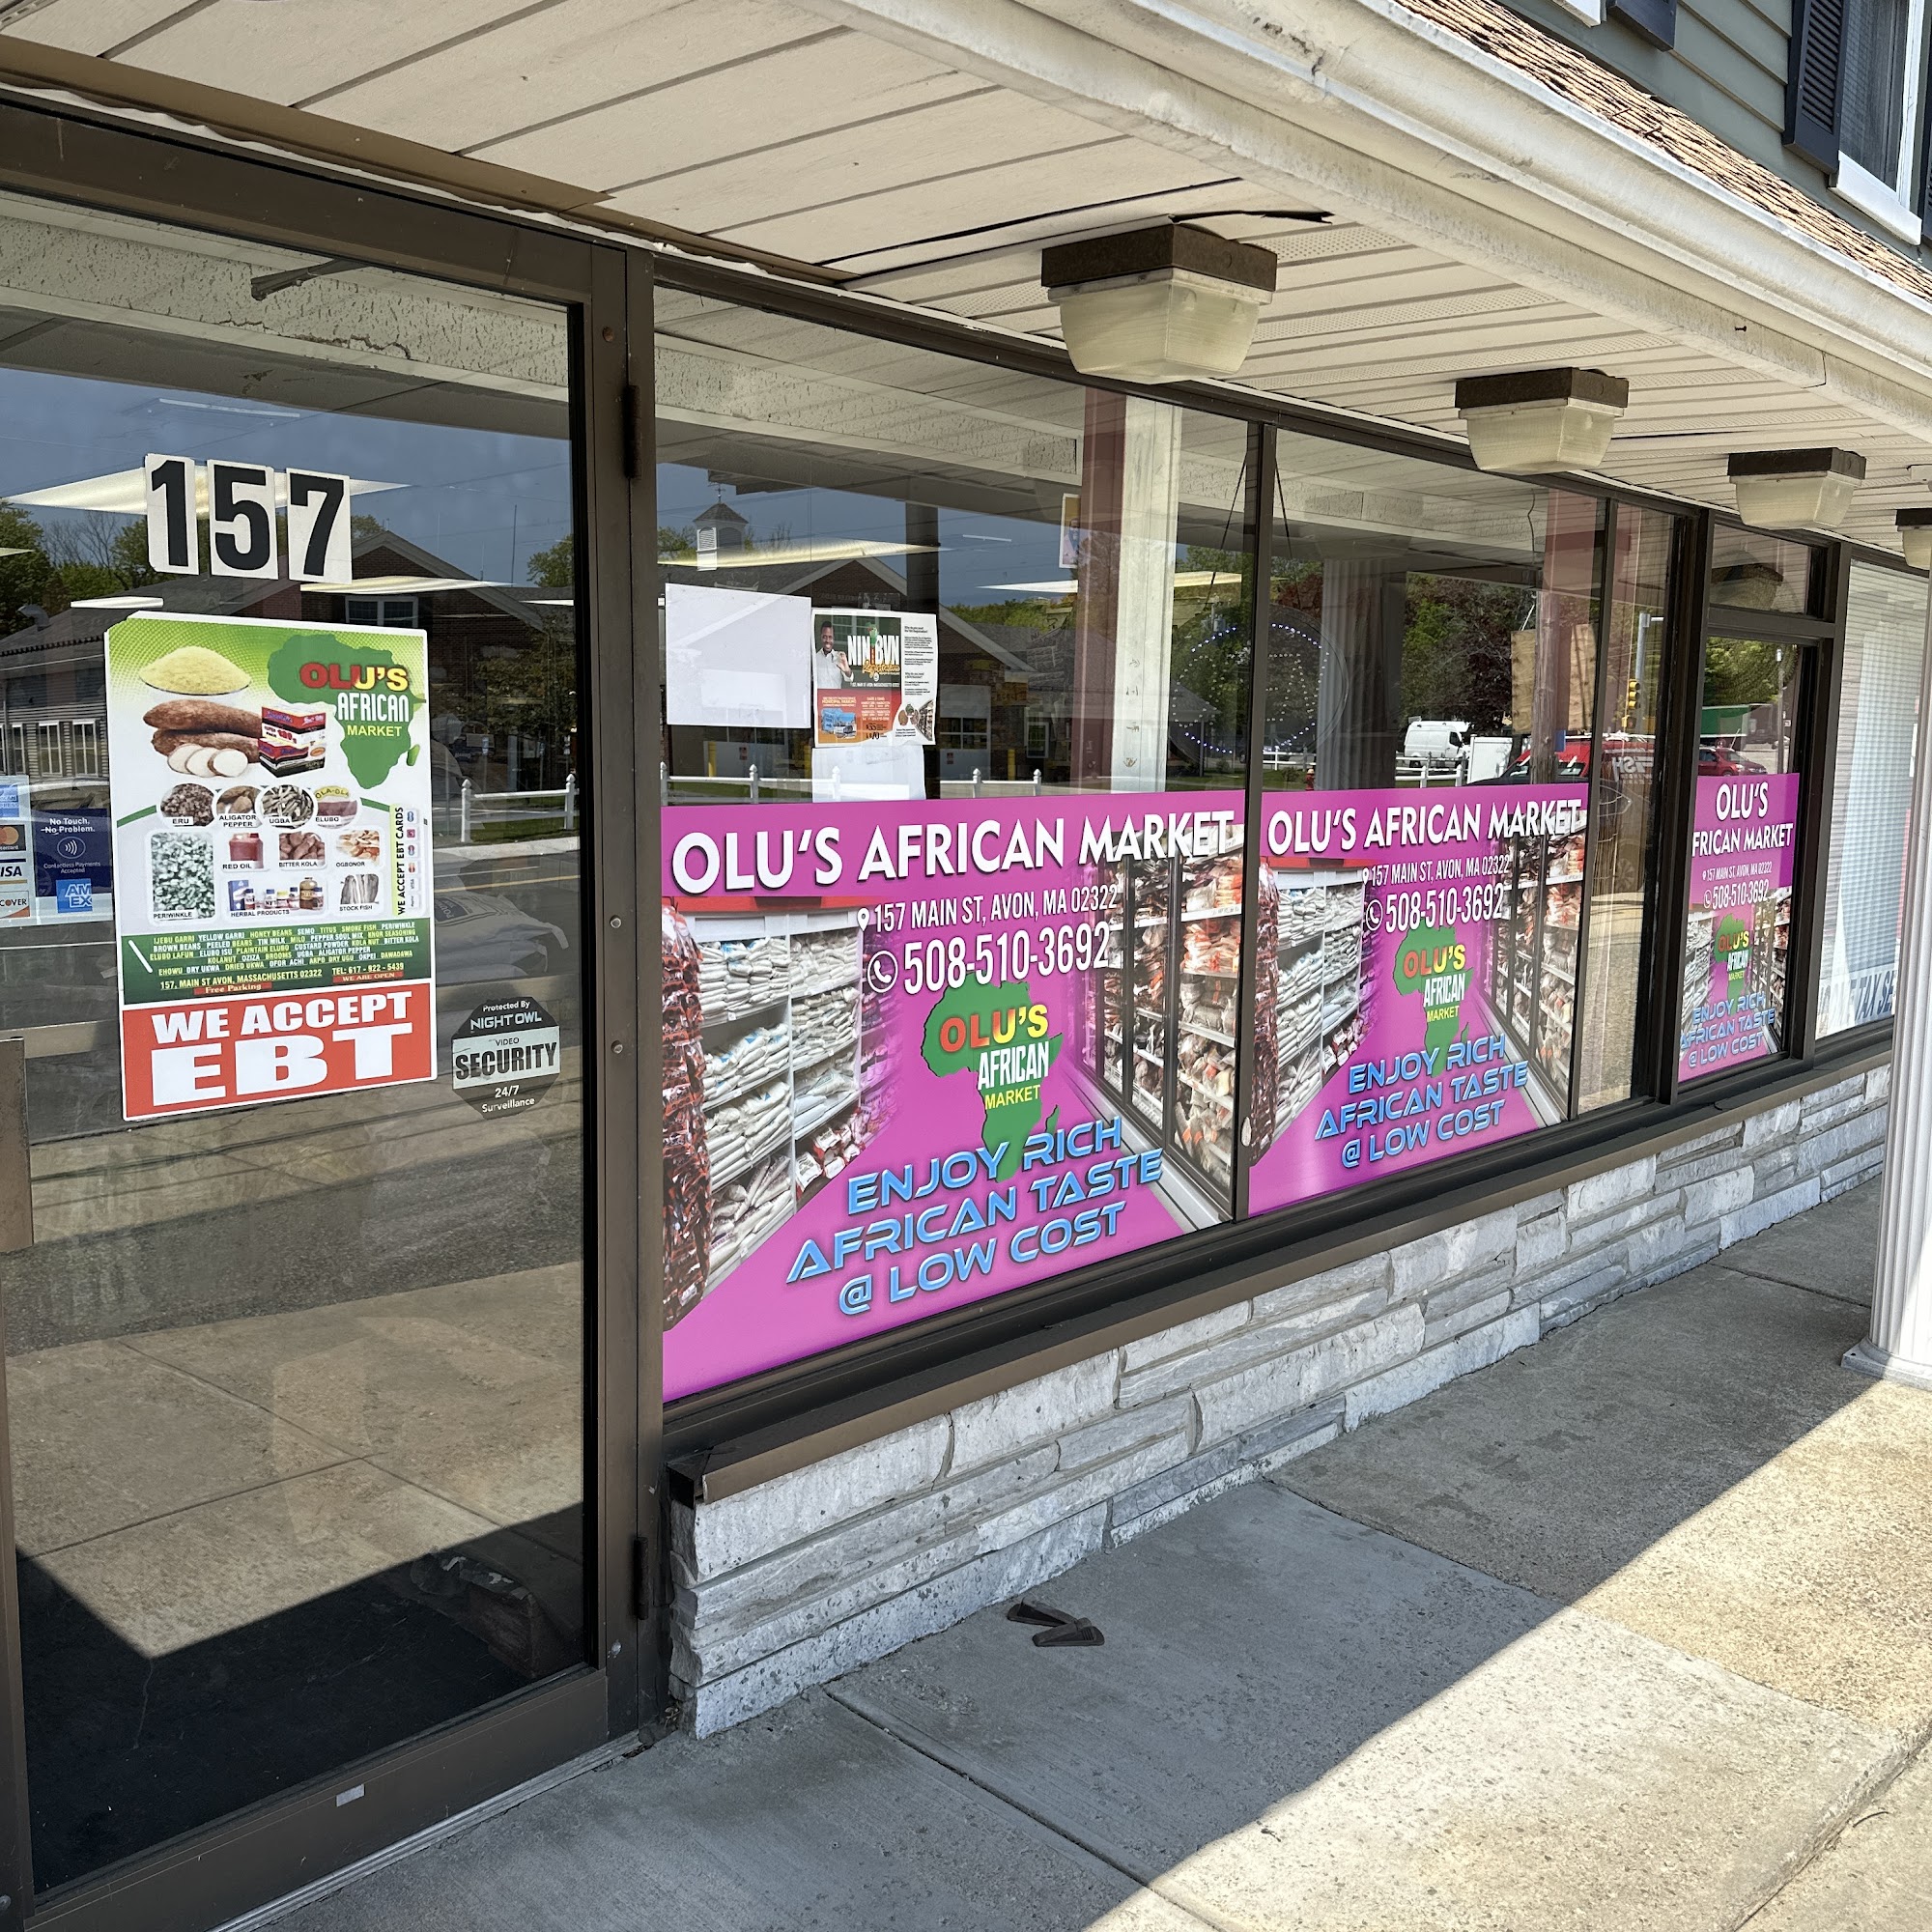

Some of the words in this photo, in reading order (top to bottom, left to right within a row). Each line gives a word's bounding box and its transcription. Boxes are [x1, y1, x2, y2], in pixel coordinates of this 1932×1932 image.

[151, 460, 345, 577] 157
[847, 635, 870, 666] NIN
[875, 635, 899, 665] BVN
[299, 662, 409, 692] OLU'S
[337, 693, 411, 723] AFRICAN
[347, 725, 403, 737] MARKET
[1716, 781, 1769, 821] OLU'S
[395, 807, 404, 838] CARDS
[1267, 808, 1357, 855] OLU'S
[1363, 803, 1482, 849] AFRICAN
[1488, 799, 1582, 839] MARKET
[395, 841, 405, 859] EBT
[673, 827, 843, 895] OLU'S
[858, 818, 1064, 881] AFRICAN
[1080, 810, 1236, 865] MARKET
[1691, 827, 1741, 858] FRICAN
[1744, 823, 1794, 855] MARKET
[0, 866, 22, 877] ISA
[396, 862, 406, 898] ACCEPT
[1371, 864, 1389, 887] 157
[1391, 863, 1418, 885] MAIN
[1435, 858, 1463, 882] AVON,
[1465, 857, 1480, 877] MA
[1481, 854, 1510, 876] 02322
[65, 884, 92, 896] AM
[70, 895, 92, 908] EX
[1713, 878, 1770, 910] 508-510-3692
[398, 900, 406, 916] WE
[875, 908, 905, 932] 157
[912, 899, 957, 928] MAIN
[991, 890, 1039, 921] AVON,
[1042, 888, 1068, 913] MA
[1072, 884, 1119, 911] 02322
[1385, 883, 1504, 933] 508-510-3692
[154, 945, 179, 953] BROWN
[180, 943, 201, 952] BEANS
[310, 933, 334, 942] PEPPER
[199, 933, 223, 942] YELLOW
[250, 930, 270, 939] HONEY
[298, 927, 315, 936] SEMO
[381, 922, 415, 930] PERIWINKLE
[295, 942, 322, 951] CUSTARD
[323, 940, 349, 949] POWDER
[384, 936, 405, 945] BITTER
[1719, 930, 1749, 952] OLU'S
[207, 955, 237, 964] KOLANUT
[318, 948, 348, 956] ALIGATOR
[348, 946, 371, 954] PEPPER
[903, 922, 1110, 994] 508-510-3692
[1404, 944, 1466, 978] OLU'S
[1727, 950, 1748, 972] AFRICAN
[179, 979, 200, 988] MAIN
[201, 978, 212, 986] ST
[237, 970, 298, 983] MASSACHUSETTS
[299, 969, 323, 978] 02322
[227, 983, 262, 993] Parking
[1424, 973, 1465, 1009] AFRICAN
[1855, 973, 1882, 1020] TAX
[1877, 970, 1894, 1014] SE
[151, 1009, 230, 1044] WE
[241, 991, 412, 1036] ACCEPT
[470, 1014, 514, 1030] NIGHT
[515, 1011, 542, 1024] OWL
[483, 1001, 519, 1012] Protected
[521, 1000, 530, 1009] By
[1427, 1005, 1460, 1022] MARKET
[1692, 999, 1735, 1025] ENJOY
[1737, 991, 1766, 1012] RICH
[495, 1037, 520, 1046] VIDEO
[940, 1003, 1048, 1053] OLU'S
[1680, 1019, 1735, 1050] AFRICAN
[1739, 1008, 1776, 1033] TASTE
[151, 1022, 412, 1107] EBT
[455, 1042, 557, 1080] SECURITY
[1349, 1047, 1440, 1094] ENJOY
[1447, 1034, 1506, 1070] RICH
[1700, 1041, 1728, 1065] LOW
[1731, 1032, 1764, 1055] COST
[977, 1041, 1049, 1092] AFRICAN
[482, 1097, 535, 1113] Surveillance
[495, 1085, 520, 1098] 24/7
[984, 1085, 1042, 1110] MARKET
[1315, 1081, 1443, 1141] AFRICAN
[1452, 1061, 1529, 1103] TASTE
[1342, 1140, 1360, 1169] @
[1370, 1120, 1430, 1162] LOW
[1437, 1099, 1506, 1141] COST
[848, 1141, 1009, 1215] ENJOY
[1022, 1115, 1122, 1173] RICH
[785, 1186, 1016, 1284] AFRICAN
[1030, 1147, 1164, 1210] TASTE
[838, 1273, 871, 1316] @
[890, 1239, 996, 1304] LOW
[1010, 1201, 1126, 1264] COST
